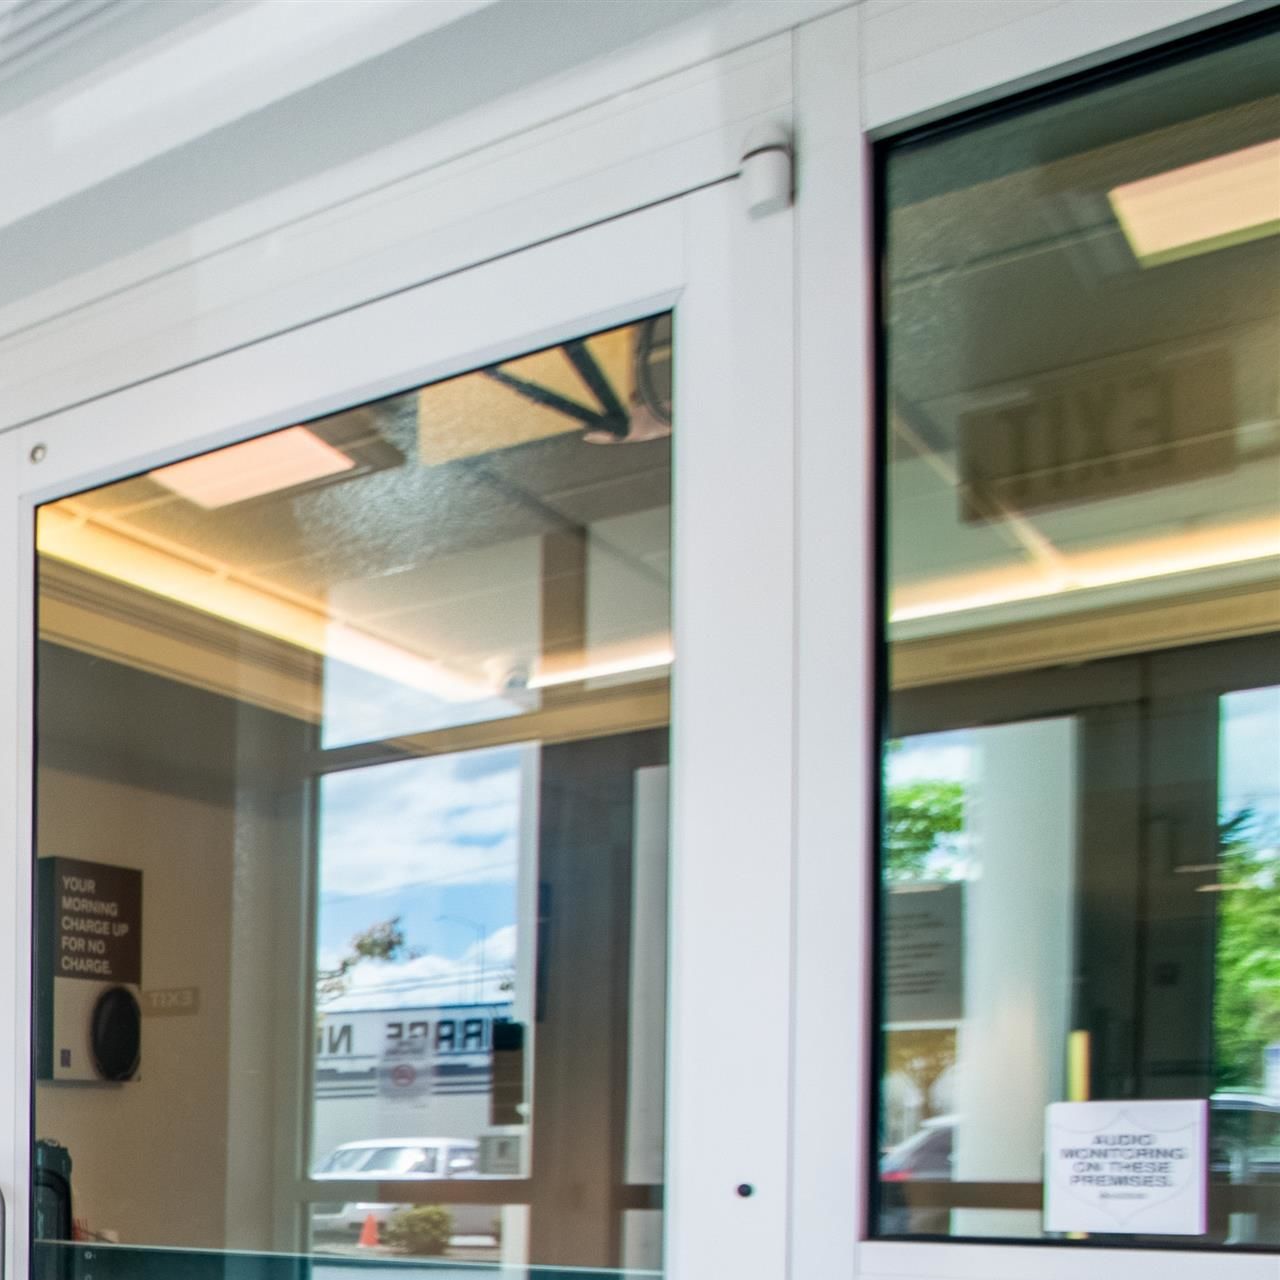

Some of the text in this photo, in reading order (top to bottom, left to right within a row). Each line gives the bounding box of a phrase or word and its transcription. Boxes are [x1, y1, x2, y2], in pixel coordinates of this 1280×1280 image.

[62, 876, 96, 894] YOUR
[62, 897, 118, 917] MORNING
[62, 918, 129, 936] CHARGE UP
[62, 938, 105, 955] FOR NO
[62, 956, 112, 975] CHARGE.
[1061, 1149, 1185, 1160] MONITORING
[1109, 1162, 1170, 1173] THESE
